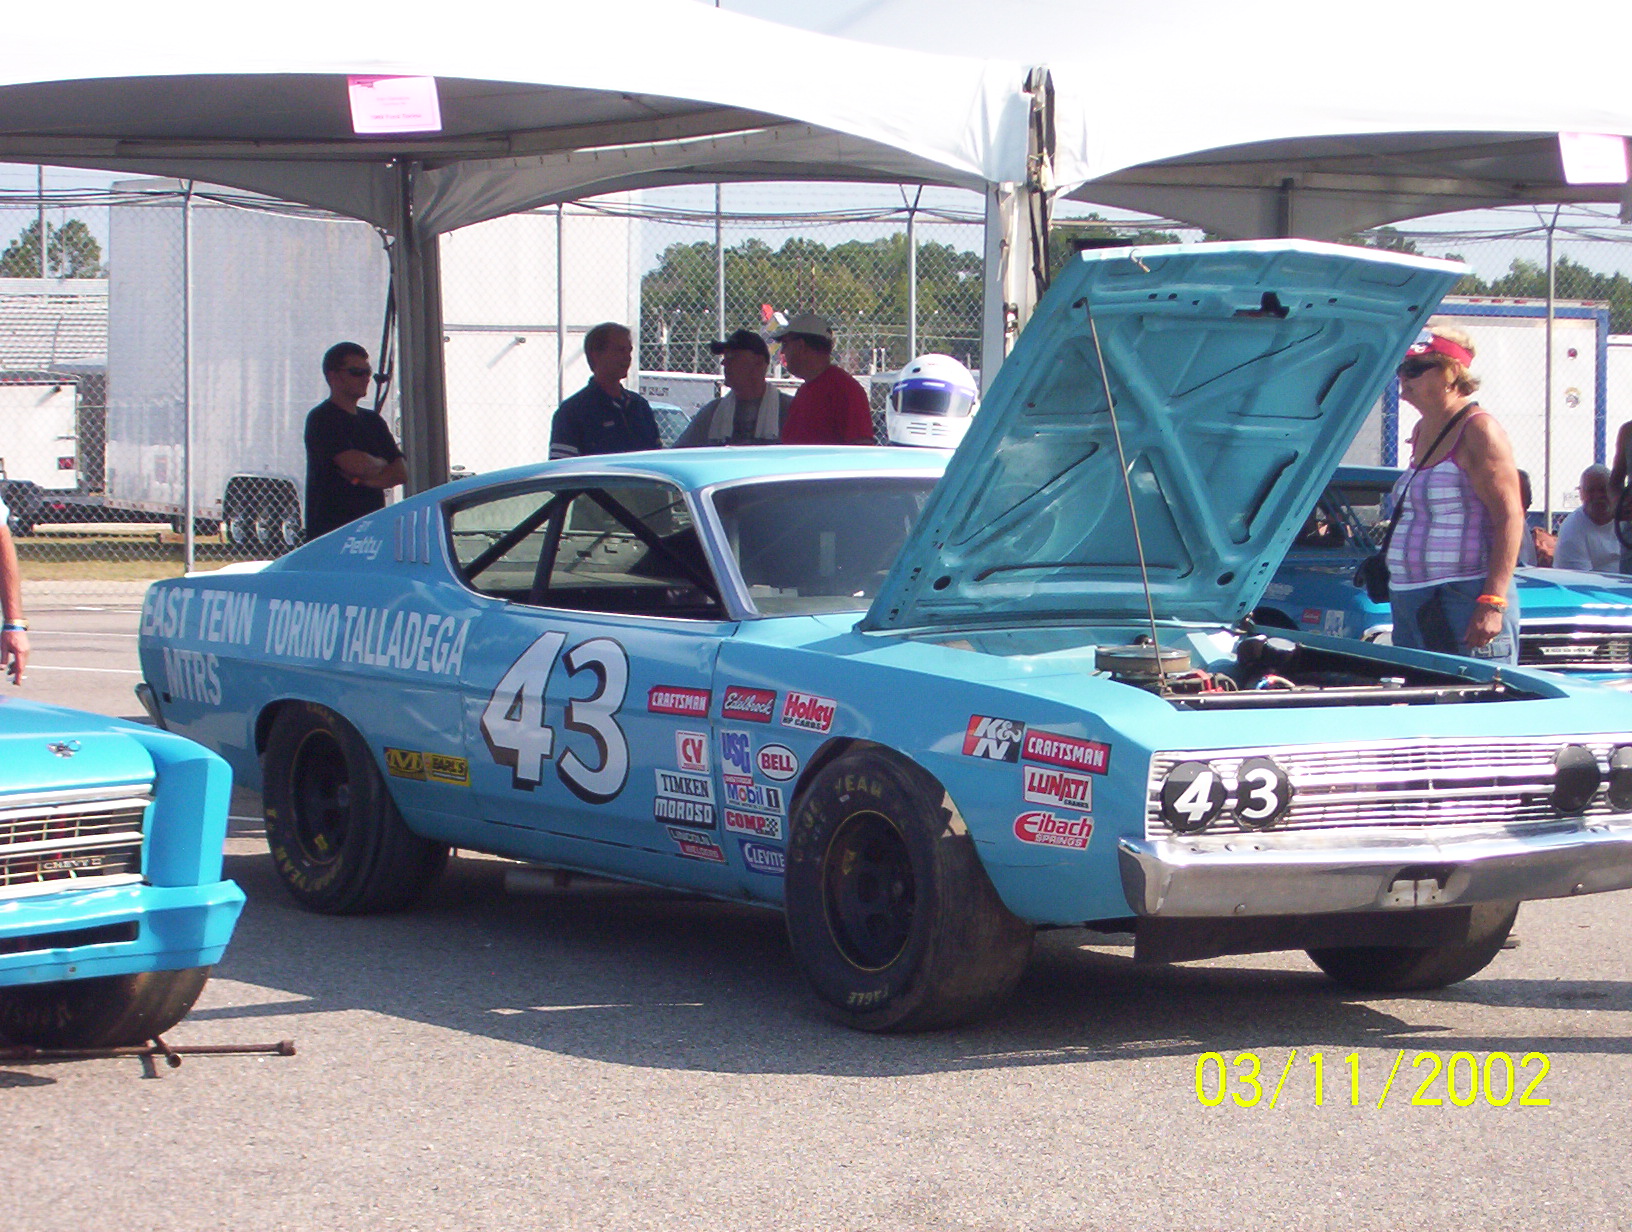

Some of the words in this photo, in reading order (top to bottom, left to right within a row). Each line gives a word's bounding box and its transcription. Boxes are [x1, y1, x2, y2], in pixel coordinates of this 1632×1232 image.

[340, 536, 383, 560] Petty
[142, 586, 194, 638] EAST
[199, 589, 257, 645] TENN
[265, 599, 340, 660] TORINO
[341, 605, 471, 675] TALLADEGA
[163, 648, 222, 705] MTRS
[652, 691, 707, 711] CRAFTSMAN
[724, 692, 772, 715] Edelbrock
[785, 694, 834, 731] Holley
[480, 629, 630, 805] 43
[682, 737, 703, 763] CV
[761, 752, 794, 772] BELL
[1027, 737, 1104, 767] CRAFTSMAN
[661, 773, 709, 798] TIMKEN
[727, 783, 764, 806] Mobil
[1027, 772, 1089, 801] LUNATI
[655, 798, 712, 823] MOROSO
[726, 810, 766, 831] COMP
[1014, 812, 1093, 842] Eibach
[1035, 834, 1083, 848] SPRINGS
[43, 858, 90, 870] CHEVY
[744, 843, 785, 867] CLEVITE
